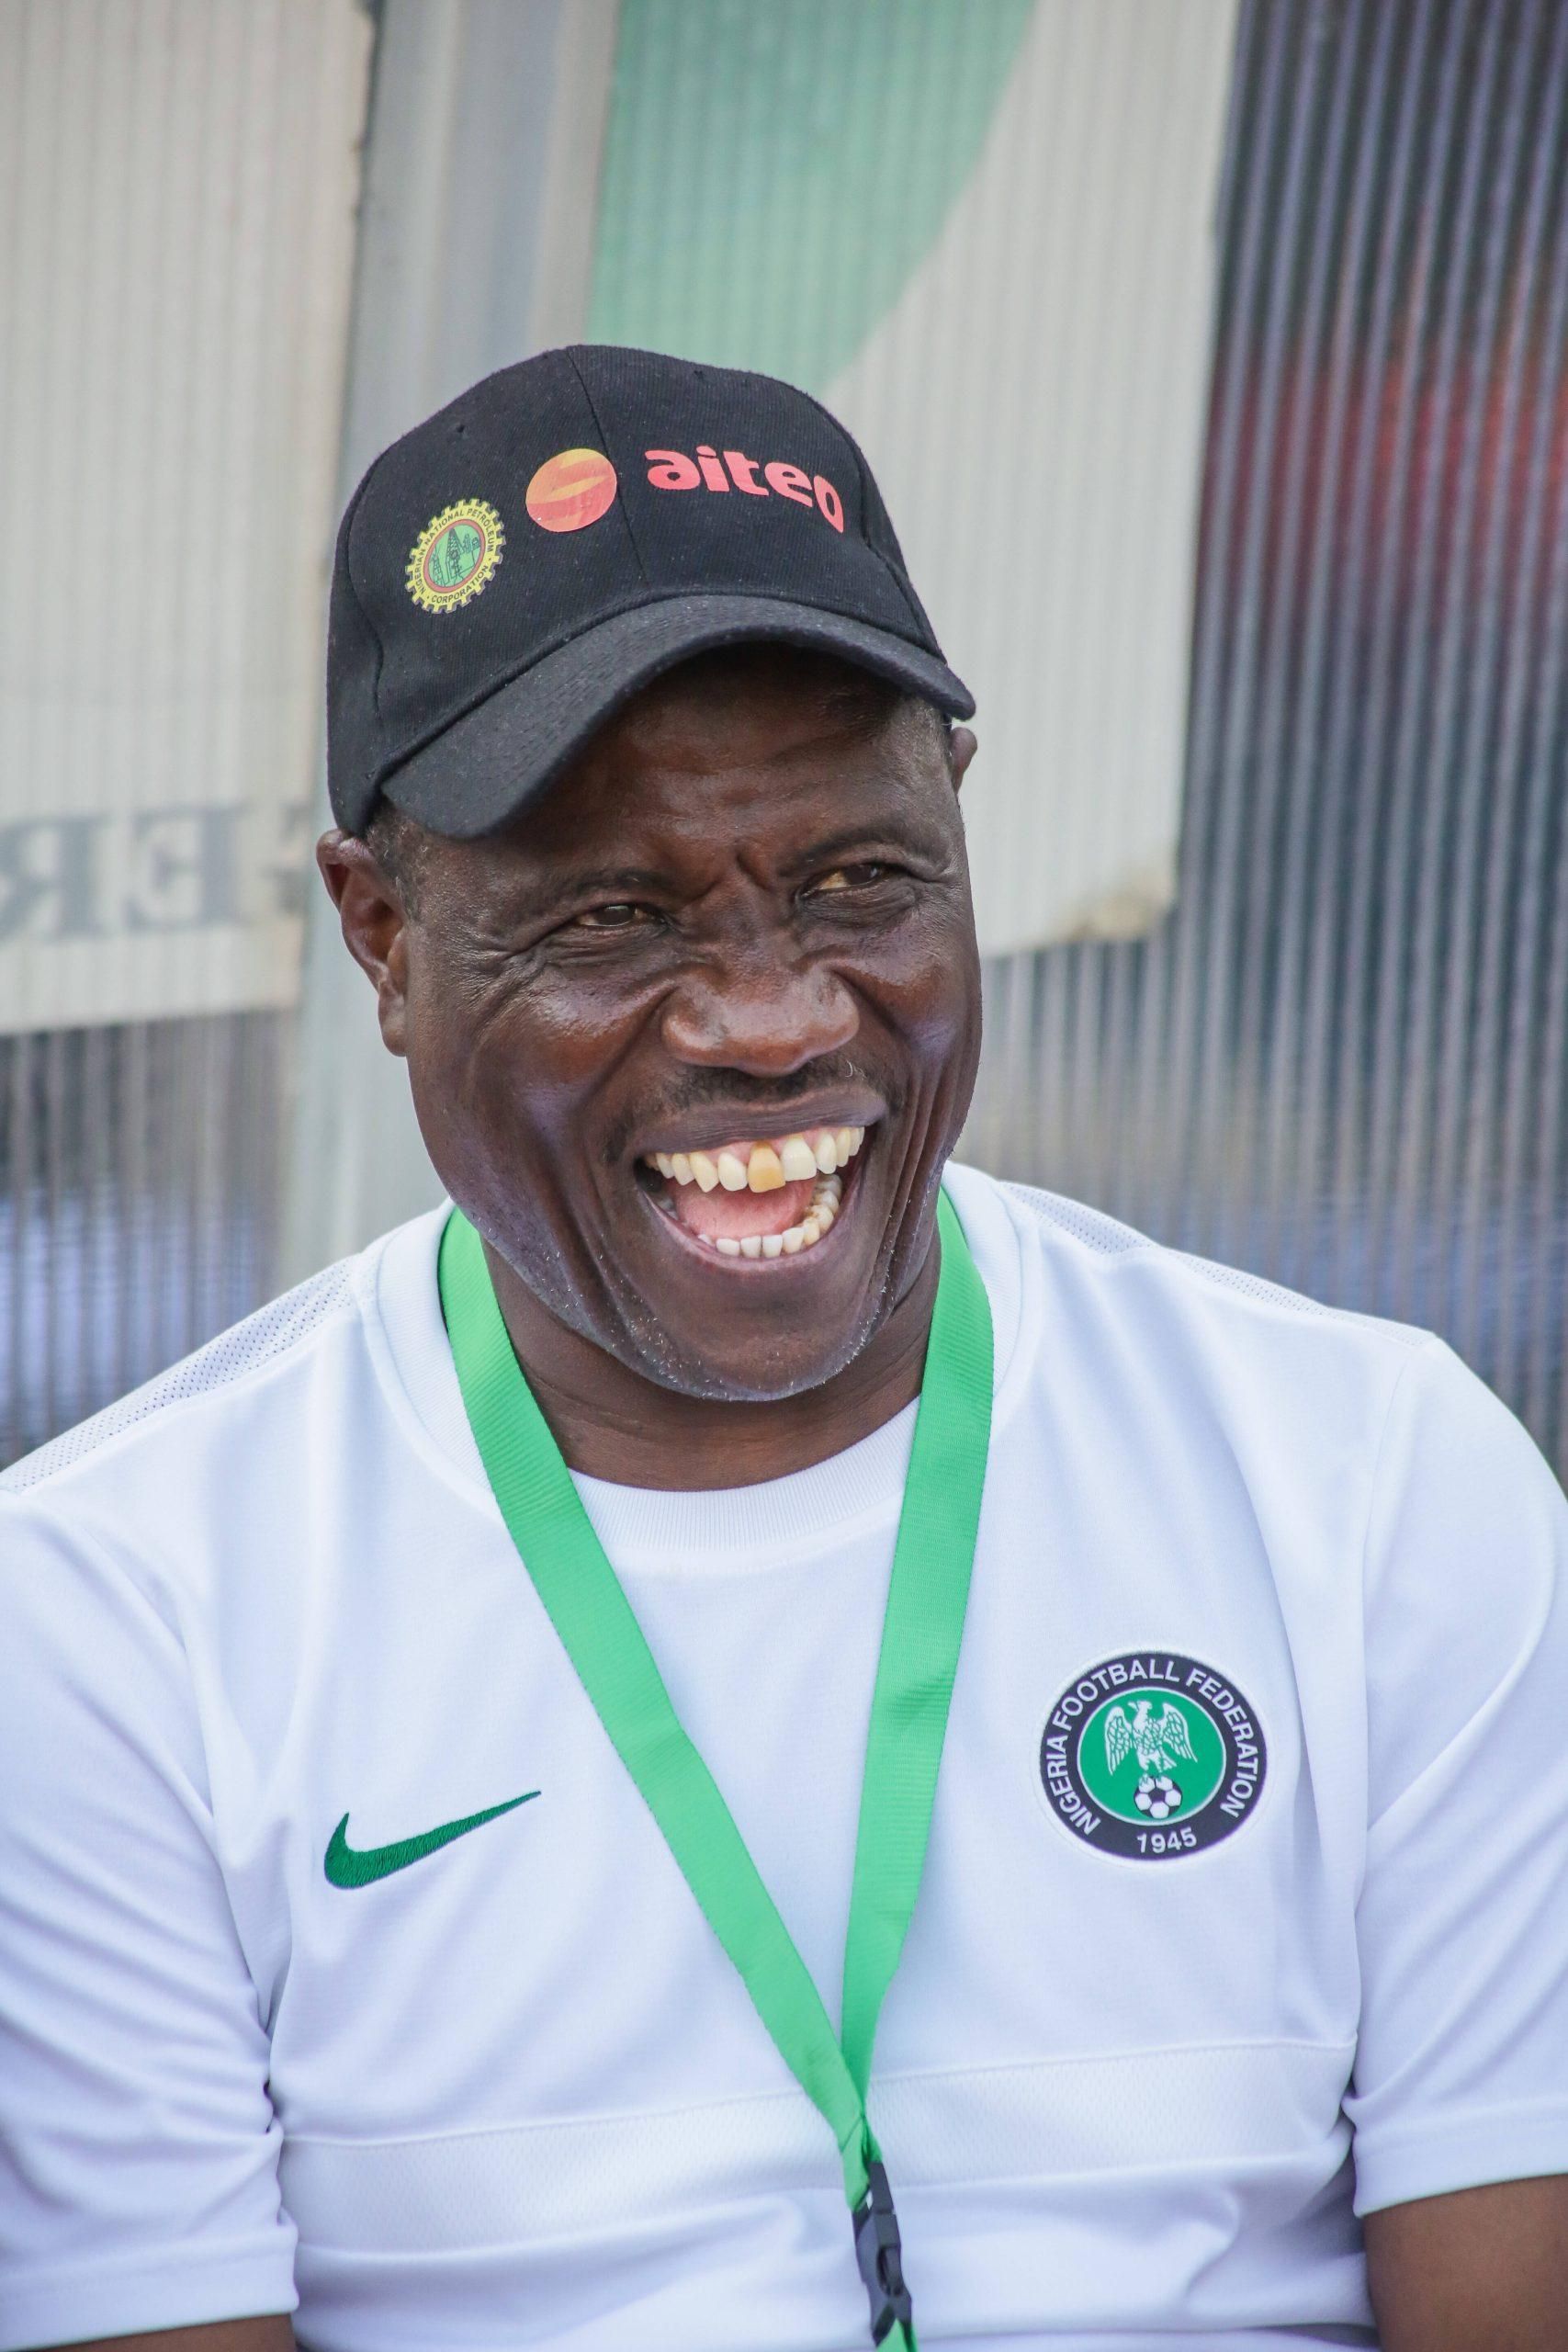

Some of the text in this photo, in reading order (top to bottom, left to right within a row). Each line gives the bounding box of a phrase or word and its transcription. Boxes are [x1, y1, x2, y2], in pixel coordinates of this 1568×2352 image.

[644, 445, 844, 533] aiteo
[414, 508, 494, 594] NIGERIAN NATIONAL PETROLEUM
[431, 565, 489, 604] CORPORATION
[1046, 1658, 1258, 1836] NIGERIA FOOTBALL FEDERATION
[1136, 1826, 1198, 1854] 1945
